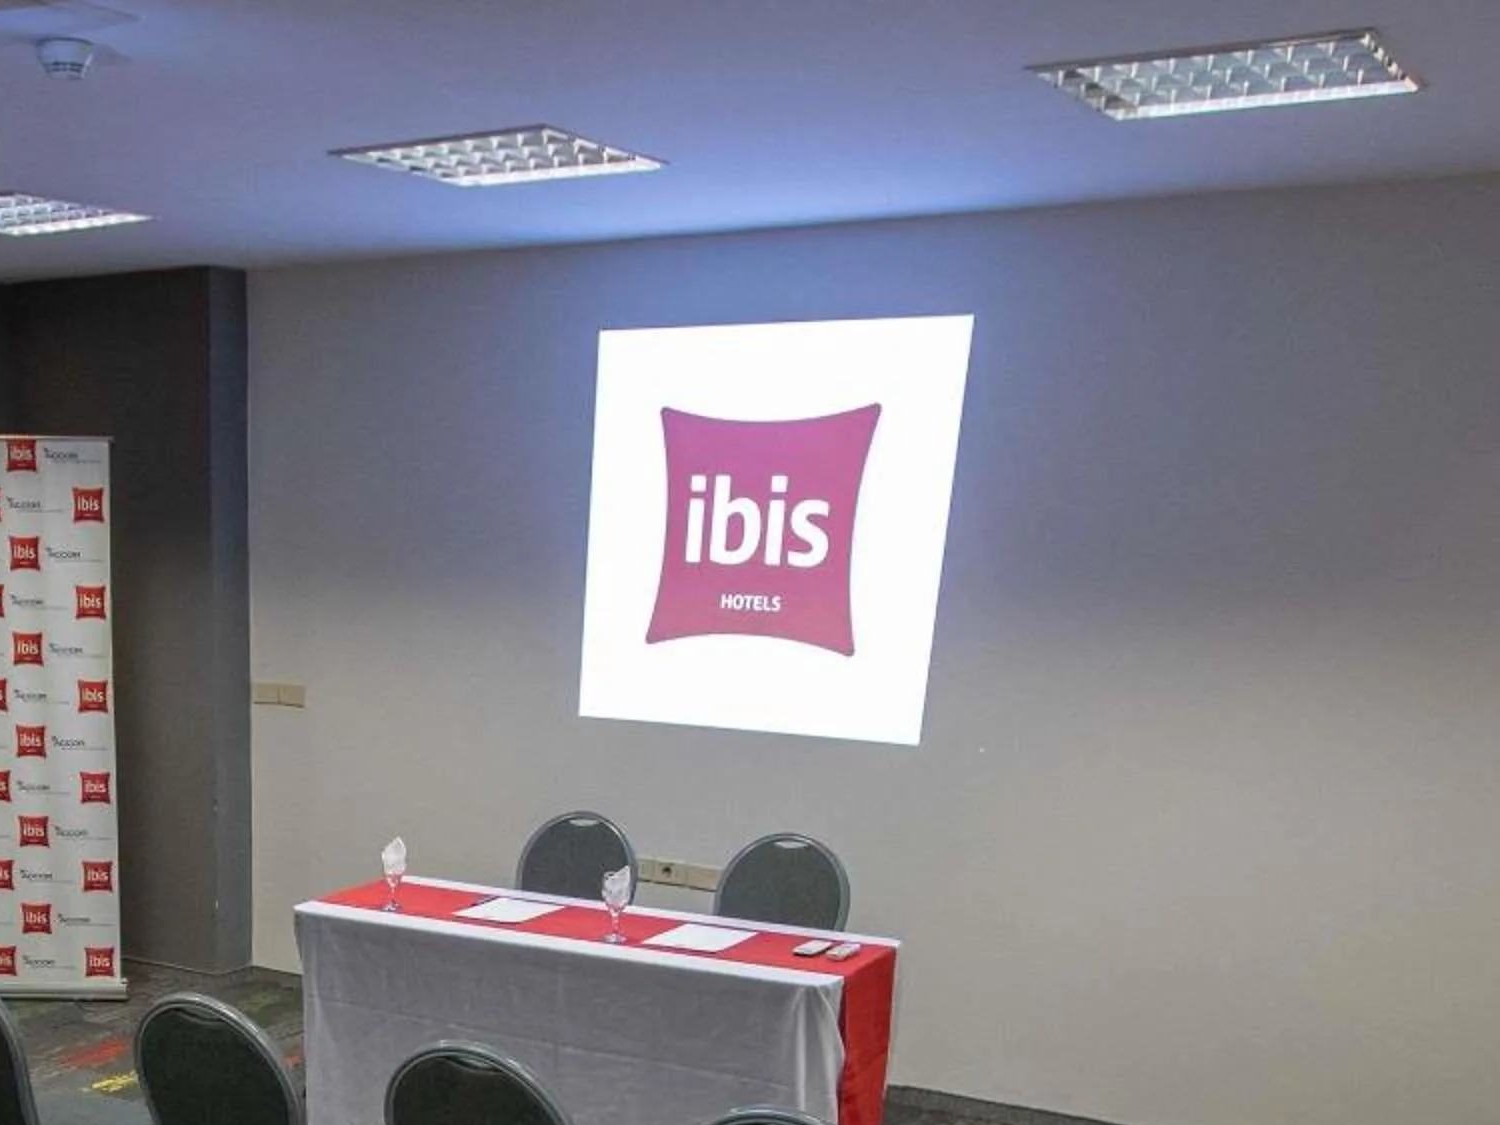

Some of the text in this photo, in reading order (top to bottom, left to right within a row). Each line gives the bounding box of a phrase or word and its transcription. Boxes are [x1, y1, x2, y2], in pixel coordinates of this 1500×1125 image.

[77, 496, 99, 510] ibis
[684, 474, 829, 568] ibis
[13, 544, 36, 559] ibis
[79, 594, 101, 608] ibis
[720, 593, 781, 612] HOTELS
[17, 640, 39, 655] ibis
[82, 687, 104, 702] ibis
[20, 732, 41, 747] ibis
[84, 780, 106, 793] ibis
[87, 867, 109, 881] ibis
[25, 911, 48, 924] ibis
[89, 955, 111, 967] ibis
